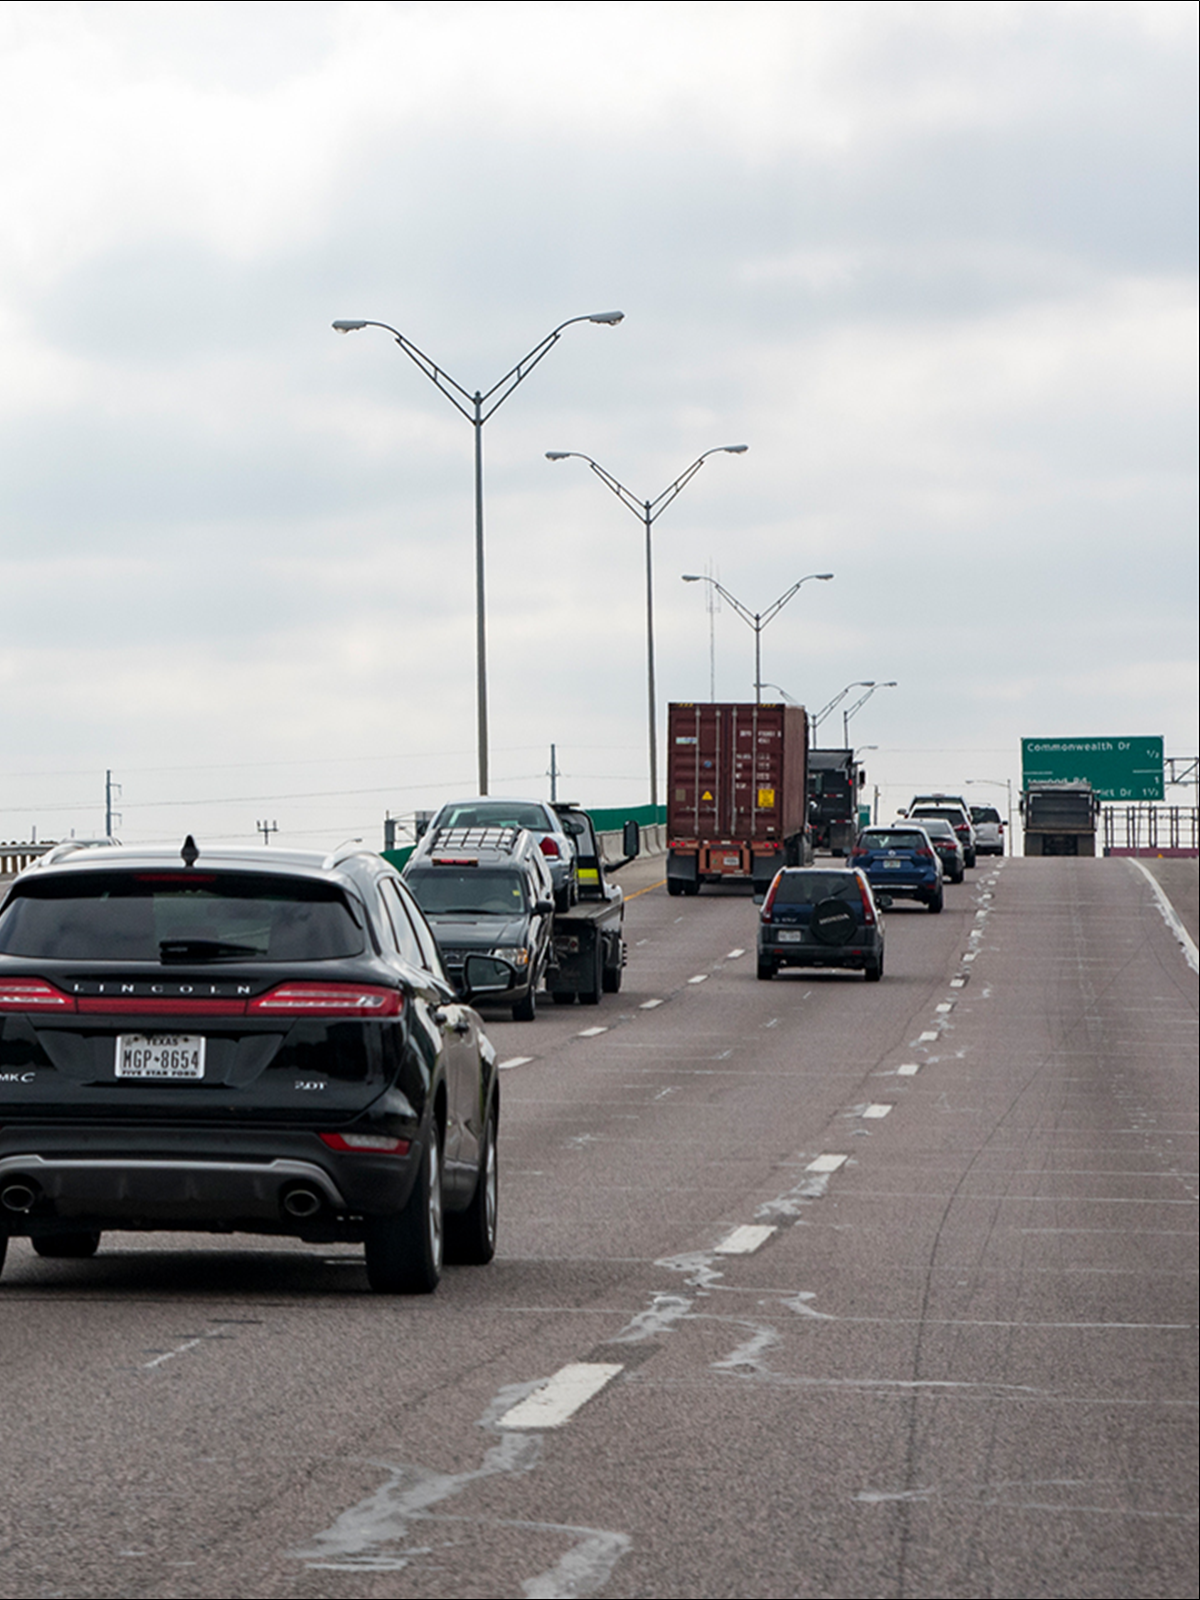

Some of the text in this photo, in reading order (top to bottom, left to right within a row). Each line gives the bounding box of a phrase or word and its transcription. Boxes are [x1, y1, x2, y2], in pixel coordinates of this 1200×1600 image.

[1027, 741, 1131, 752] Commonwealth Dr
[1120, 788, 1132, 797] Dr
[74, 984, 250, 994] LINCOLN
[146, 1037, 179, 1046] TEXAS
